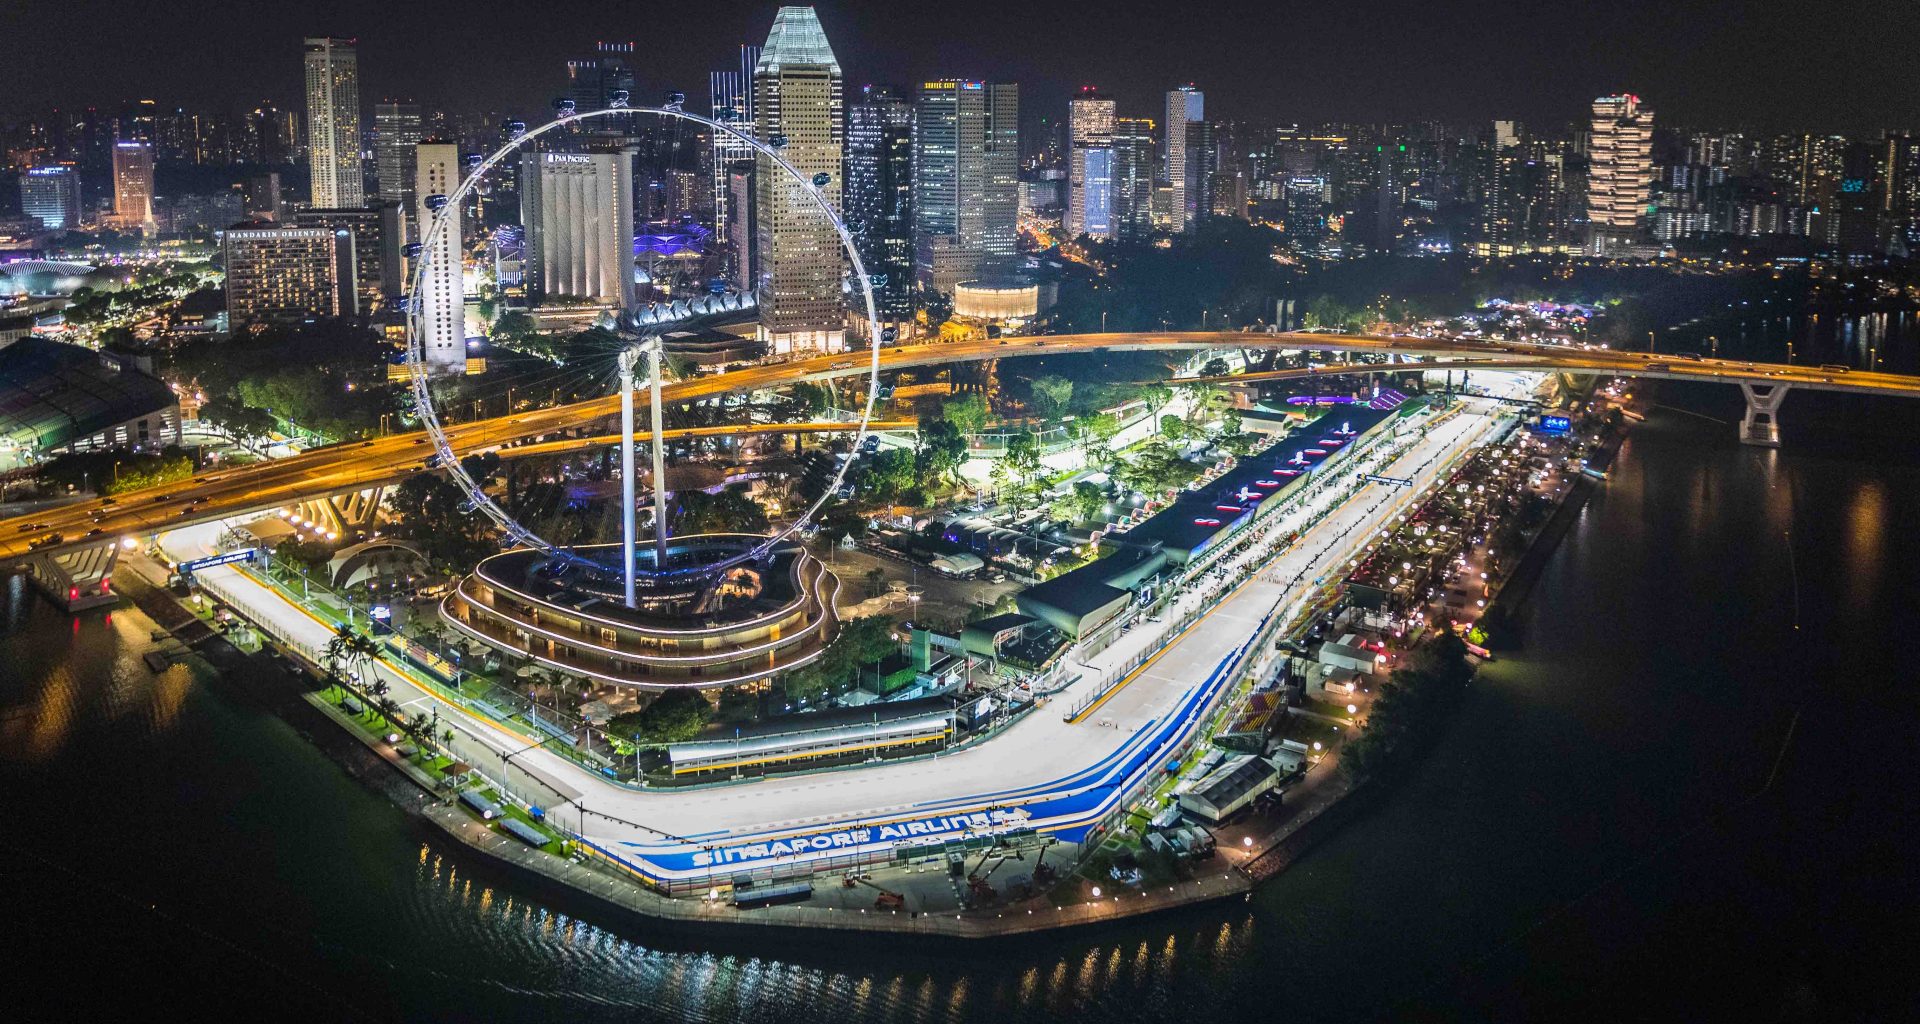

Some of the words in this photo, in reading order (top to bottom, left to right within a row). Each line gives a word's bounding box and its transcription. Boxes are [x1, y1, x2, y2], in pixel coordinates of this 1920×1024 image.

[554, 154, 567, 162] PAN
[567, 154, 590, 163] PACIFIC
[229, 231, 277, 239] MANDARIN
[281, 230, 326, 238] ORIENTAL
